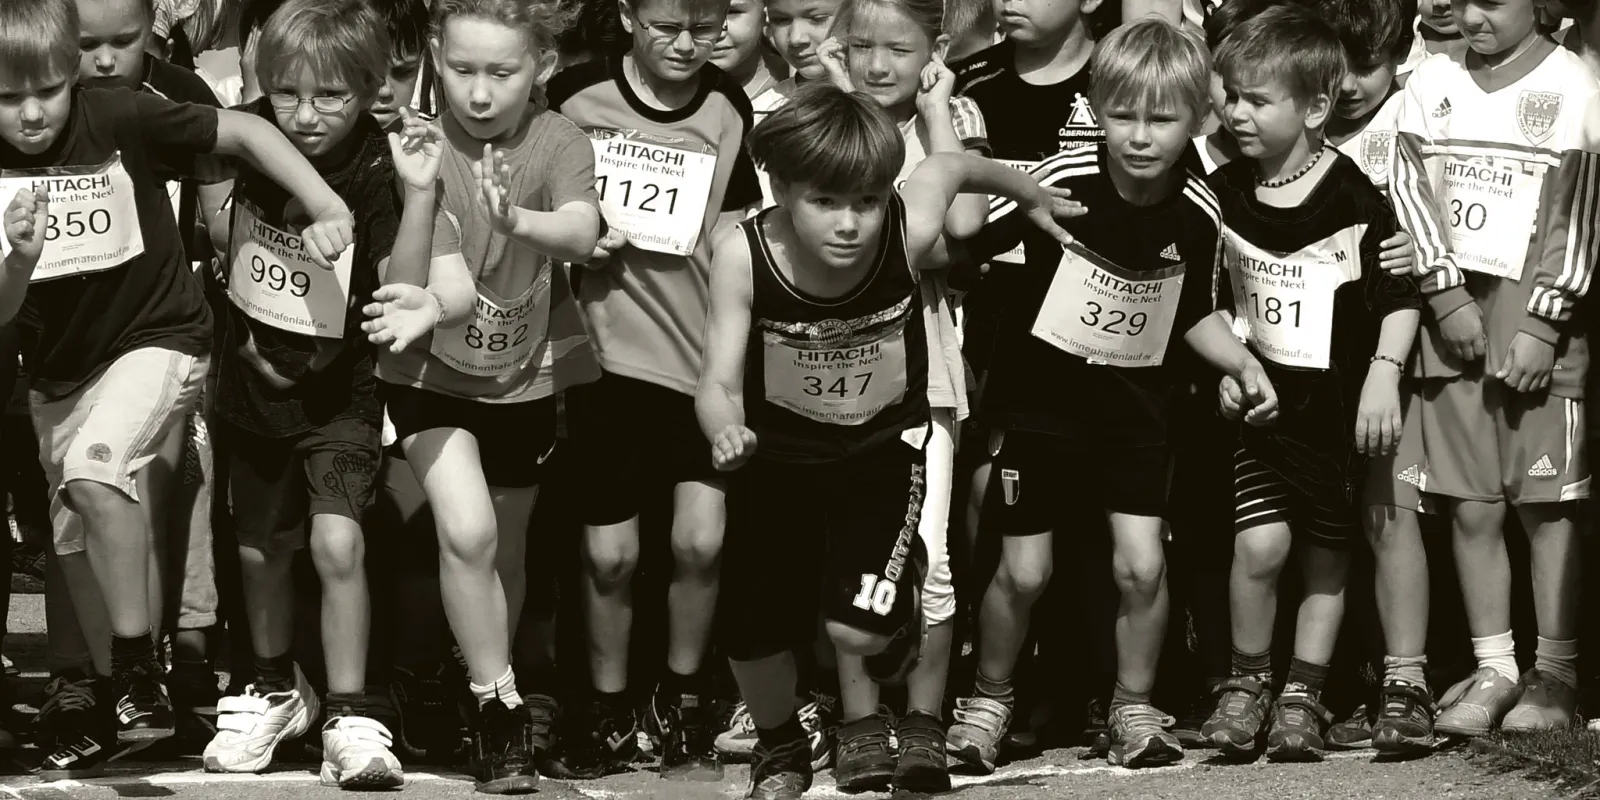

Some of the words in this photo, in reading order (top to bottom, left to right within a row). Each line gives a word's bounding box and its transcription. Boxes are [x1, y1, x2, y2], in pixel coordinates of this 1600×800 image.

[1058, 127, 1106, 137] OBERHAUSE
[600, 154, 638, 170] Inspire
[641, 163, 659, 174] the
[661, 166, 685, 178] Next
[606, 141, 685, 166] HITACHI
[1444, 161, 1512, 187] HITACHI
[70, 193, 88, 203] the
[91, 185, 115, 200] Next
[597, 174, 679, 215] 1121
[1468, 181, 1484, 192] the
[1488, 185, 1513, 199] Next
[1450, 199, 1487, 231] 30
[253, 218, 306, 251] HITAC
[277, 247, 294, 260] the
[297, 252, 314, 264] Ne
[1238, 252, 1303, 279] HITACHI
[250, 254, 311, 298] 999
[1091, 268, 1163, 296] HITACHI
[1262, 276, 1277, 287] the
[1280, 279, 1306, 291] Next
[1083, 278, 1119, 301] Inspire
[1121, 295, 1139, 304] the
[1140, 294, 1162, 304] Next
[1080, 301, 1148, 337] 329
[464, 323, 529, 352] 882
[793, 359, 833, 371] Inspire
[837, 361, 855, 370] the
[859, 352, 883, 367] Next
[797, 343, 880, 362] HITACHI
[802, 371, 874, 398] 347
[1528, 467, 1558, 477] adidas
[853, 573, 897, 616] 10
